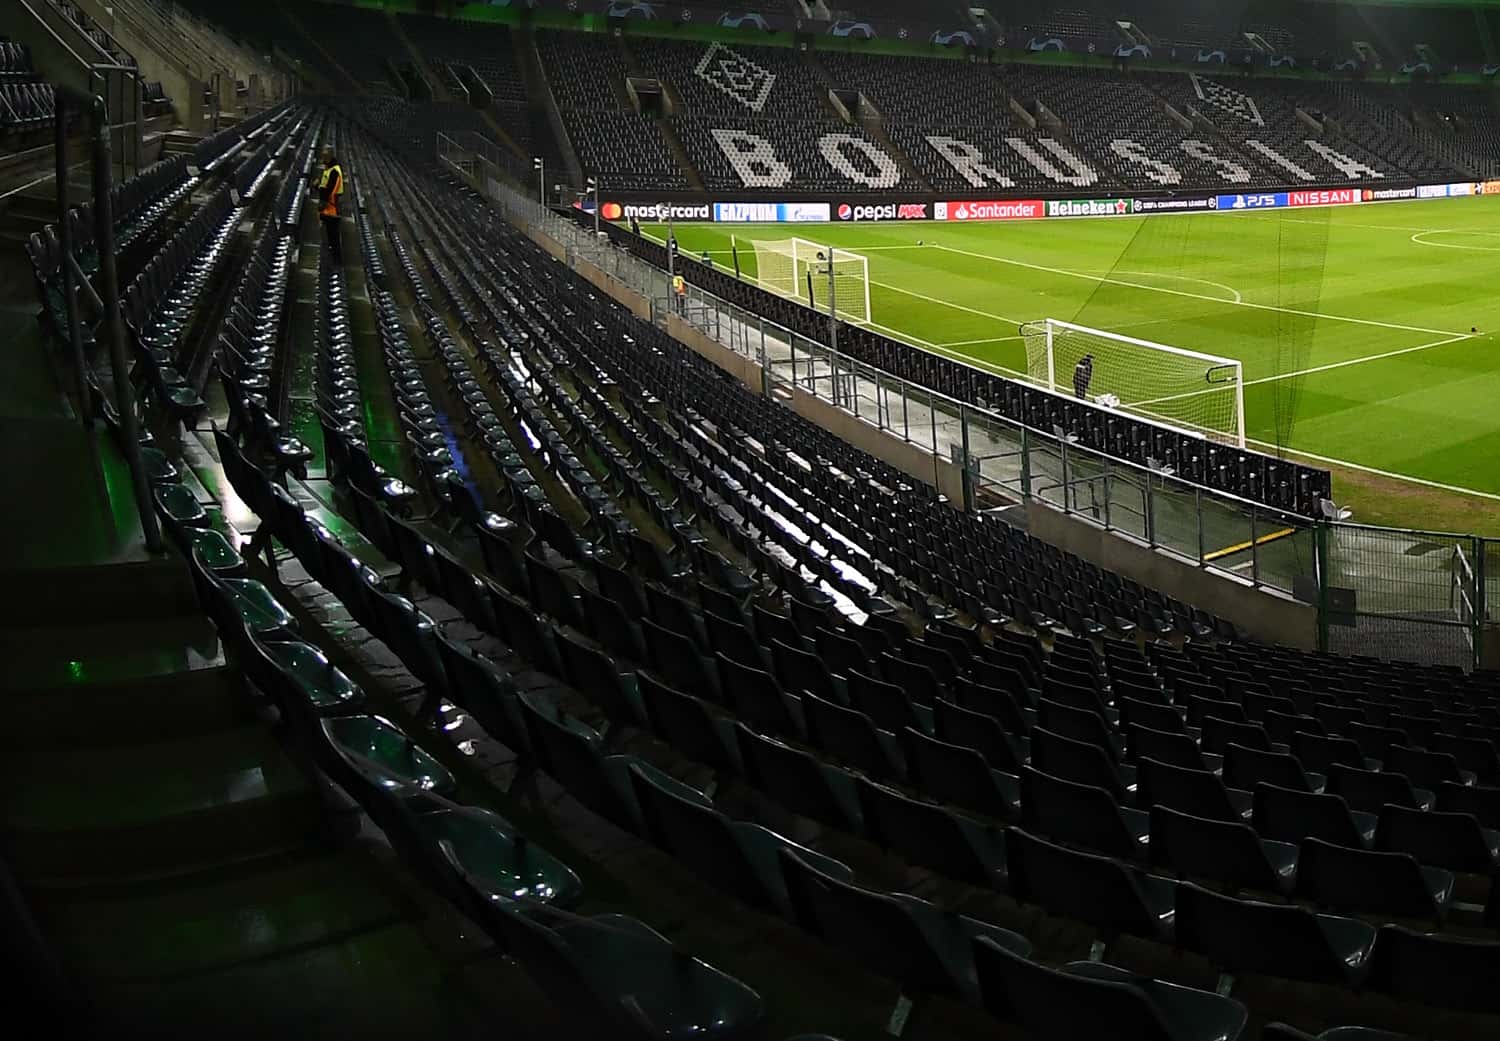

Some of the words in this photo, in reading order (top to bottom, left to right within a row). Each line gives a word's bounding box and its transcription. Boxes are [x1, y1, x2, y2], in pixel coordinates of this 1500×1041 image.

[711, 128, 1384, 189] BORUSSIA
[1247, 195, 1276, 207] PS5
[1293, 191, 1351, 205] NISSAN
[623, 203, 709, 218] mastercard
[853, 204, 896, 221] pepsi
[969, 202, 1036, 218] Santander
[1048, 200, 1115, 217] Heineken
